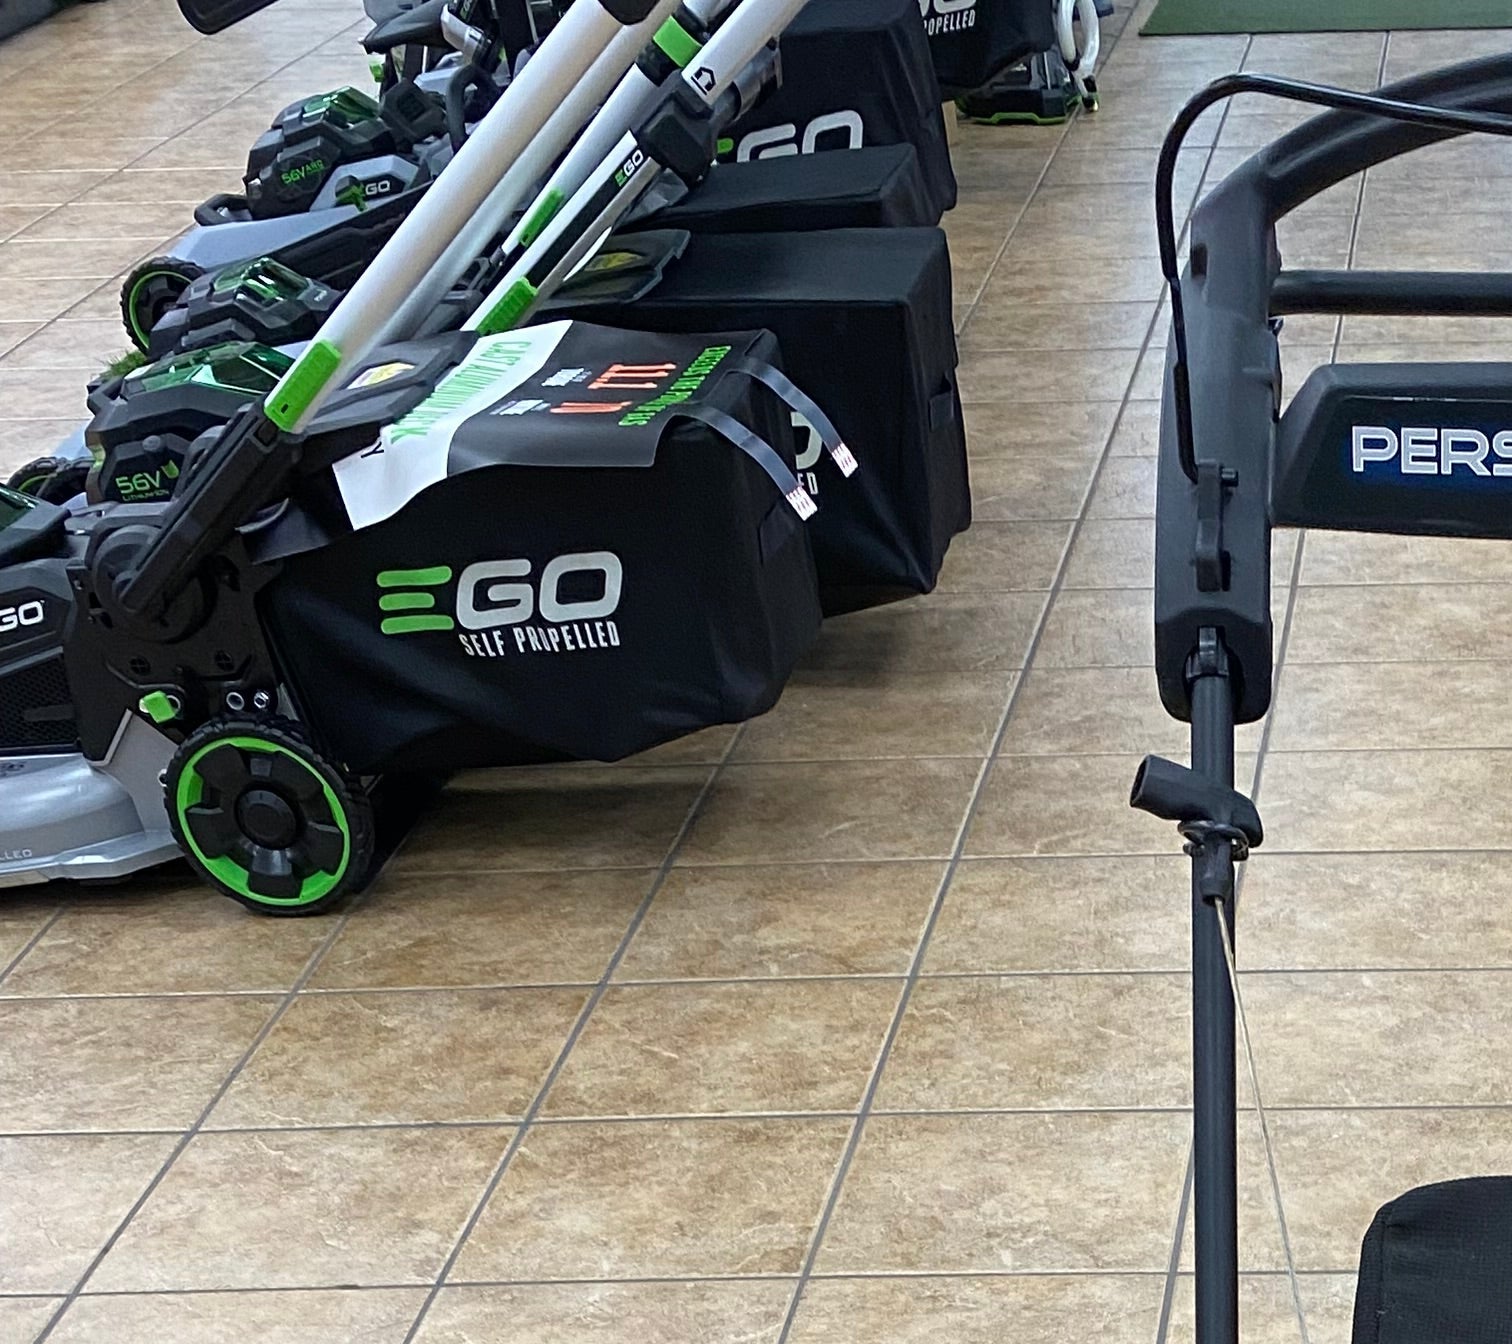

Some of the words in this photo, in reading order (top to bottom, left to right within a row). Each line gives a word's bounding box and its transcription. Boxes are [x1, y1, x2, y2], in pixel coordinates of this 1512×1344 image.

[924, 9, 976, 36] OPELLED
[717, 109, 864, 163] GO
[614, 149, 644, 187] EGO
[115, 469, 160, 494] 56V
[376, 551, 622, 634] EGO
[0, 601, 44, 632] GO
[458, 629, 504, 657] SELF
[513, 620, 620, 653] PROPELLED
